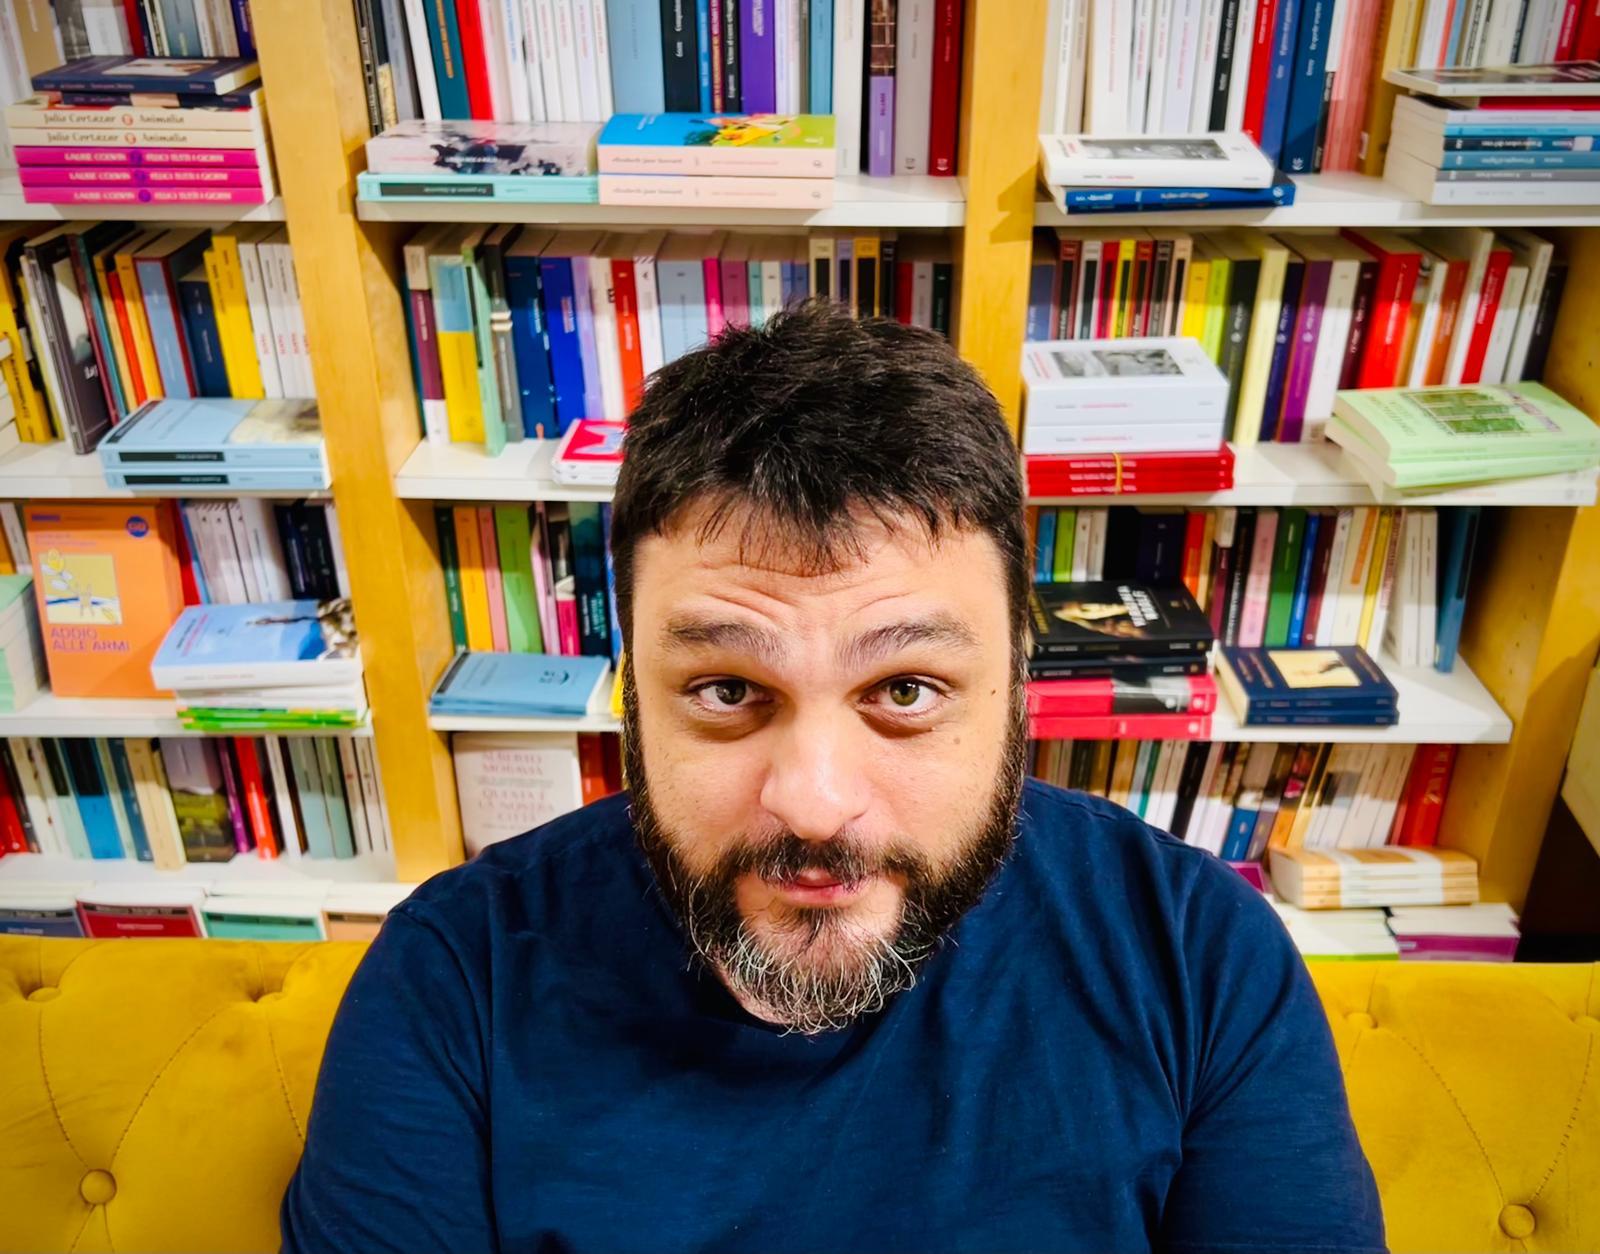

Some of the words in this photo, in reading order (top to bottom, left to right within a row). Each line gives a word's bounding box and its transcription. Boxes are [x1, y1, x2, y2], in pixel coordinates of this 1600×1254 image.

[51, 627, 98, 640] ADDIO
[53, 639, 85, 651] ALLE
[93, 641, 130, 653] ARMI
